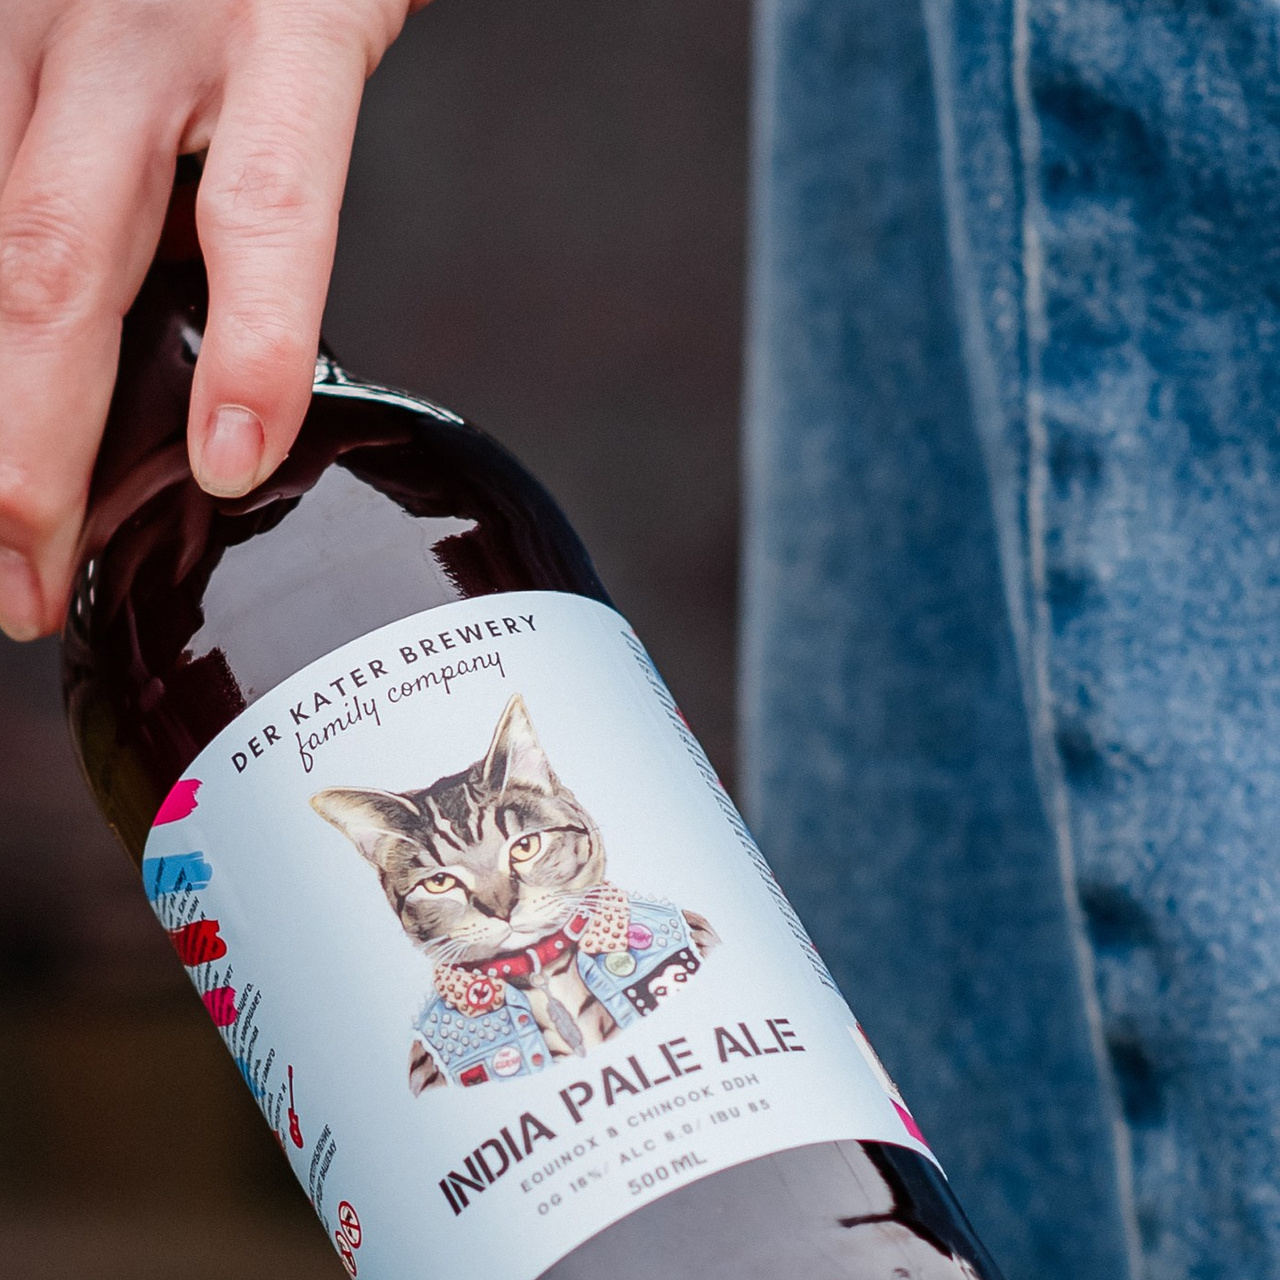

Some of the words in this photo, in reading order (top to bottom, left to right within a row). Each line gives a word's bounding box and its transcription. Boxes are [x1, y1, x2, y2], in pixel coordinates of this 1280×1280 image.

[231, 724, 282, 773] DER
[289, 658, 389, 725] KATER
[399, 614, 537, 665] BREWERY
[295, 695, 381, 773] family
[387, 651, 506, 704] company
[438, 1111, 557, 1216] INDIA
[558, 1037, 703, 1124] PALE
[713, 1018, 806, 1063] ALE
[537, 1193, 563, 1216] OG
[619, 1139, 656, 1165] ALC
[709, 1107, 741, 1125] IBU
[627, 1085, 715, 1128] CHINOOK
[722, 1073, 760, 1093] DDH
